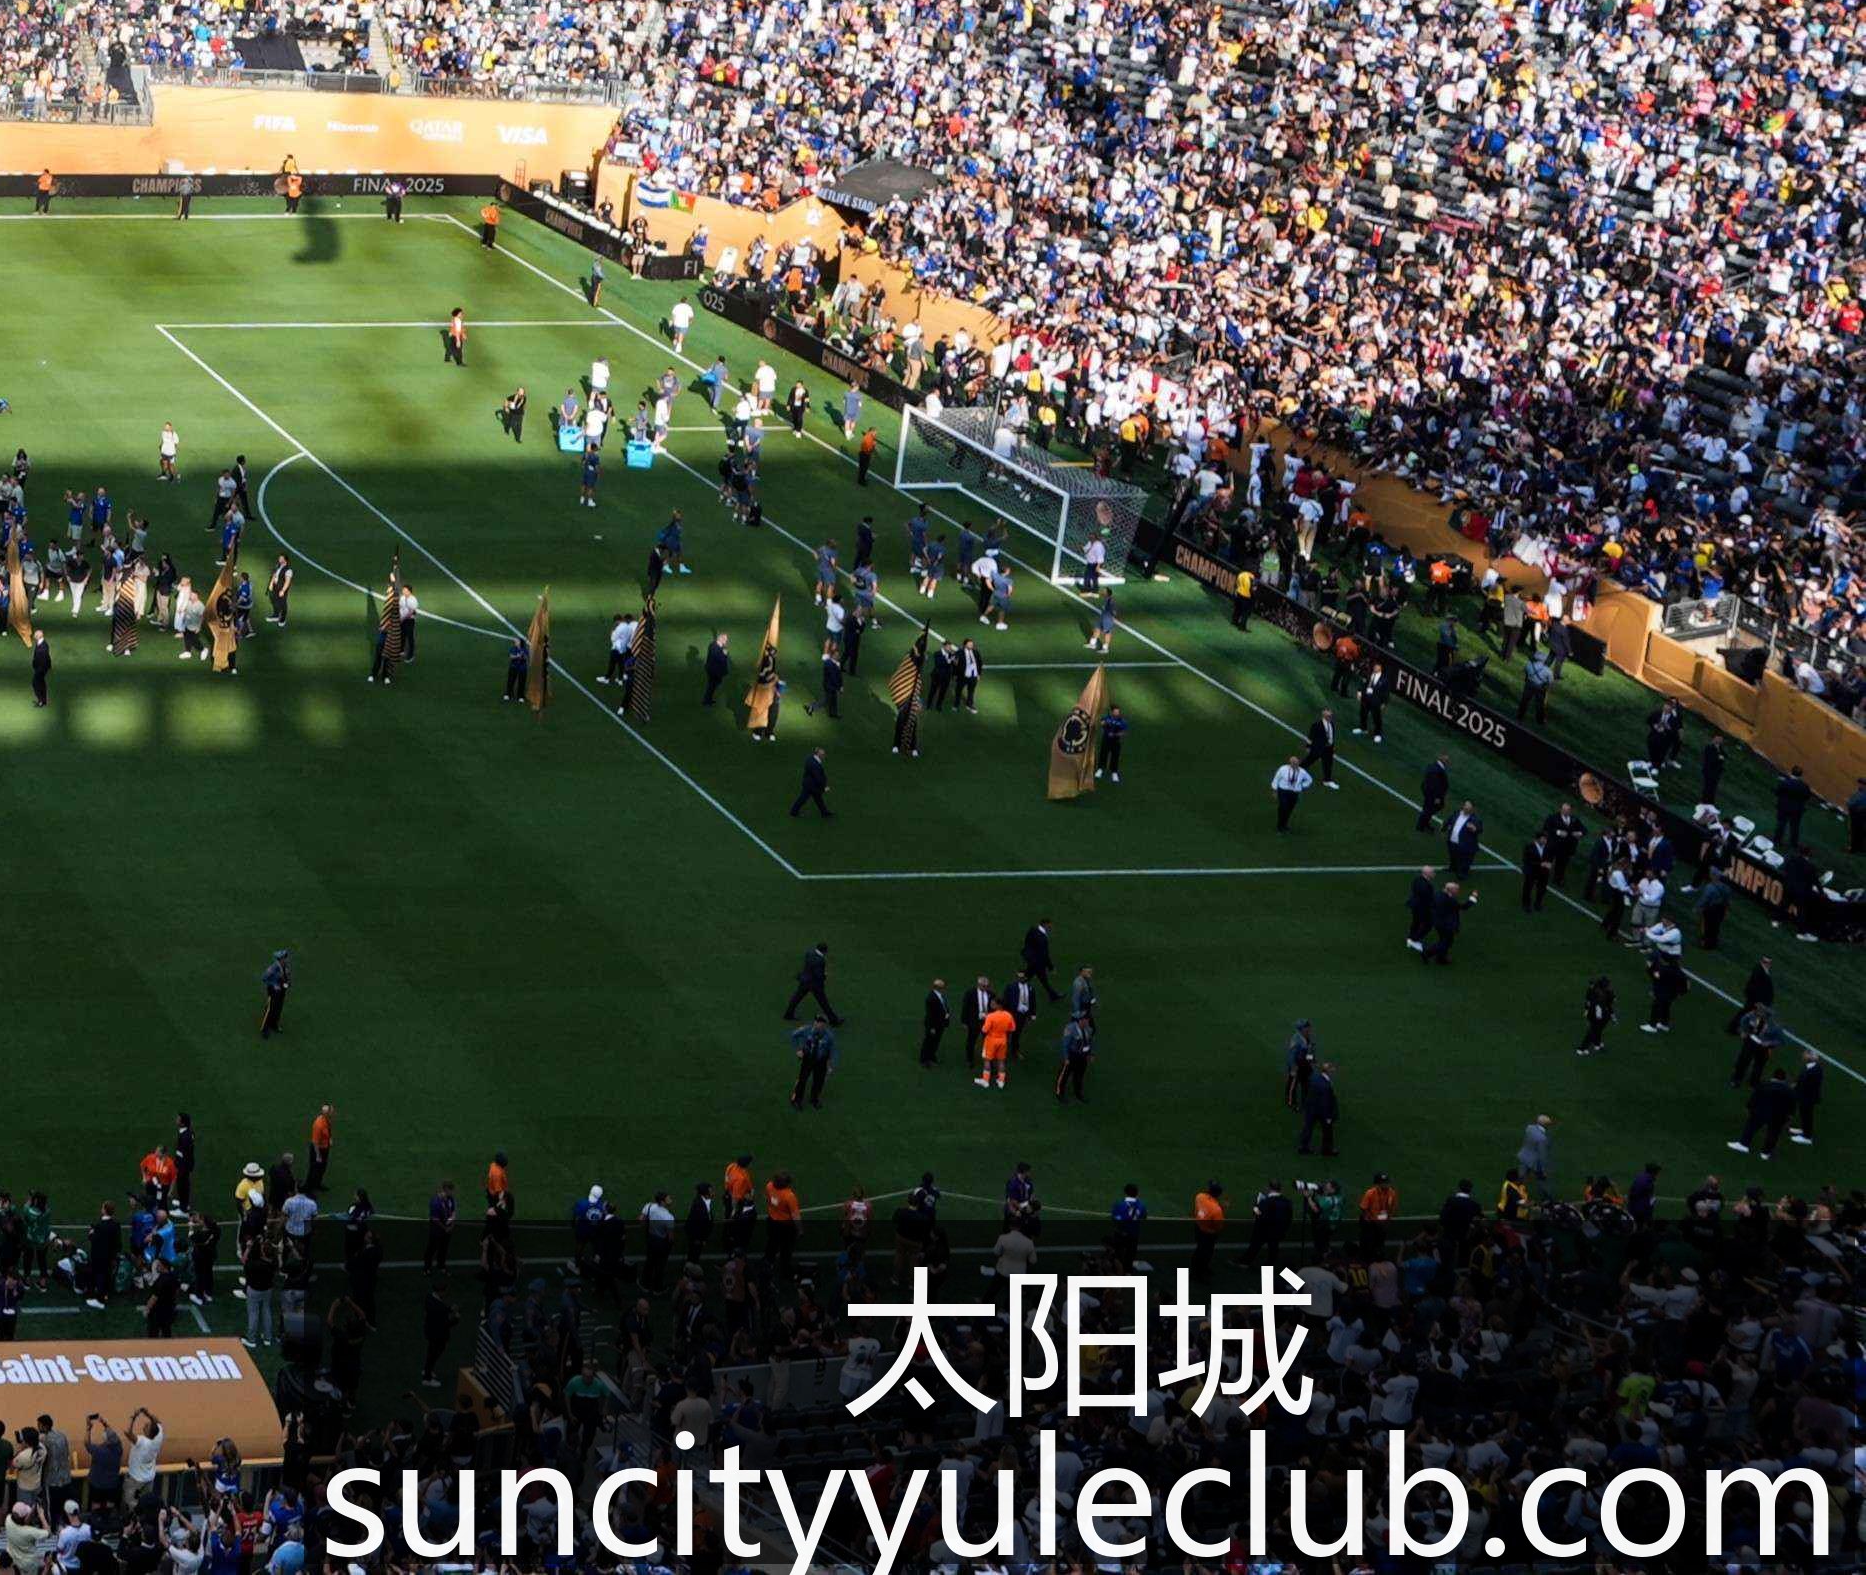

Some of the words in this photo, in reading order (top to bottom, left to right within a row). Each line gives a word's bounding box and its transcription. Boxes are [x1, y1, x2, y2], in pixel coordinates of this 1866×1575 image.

[253, 115, 297, 132] FIFA
[497, 122, 549, 145] VISA
[353, 178, 391, 193] FINA
[1175, 543, 1236, 596] CHAMPION
[1395, 669, 1454, 721] FINAL
[1456, 703, 1507, 749] 2025
